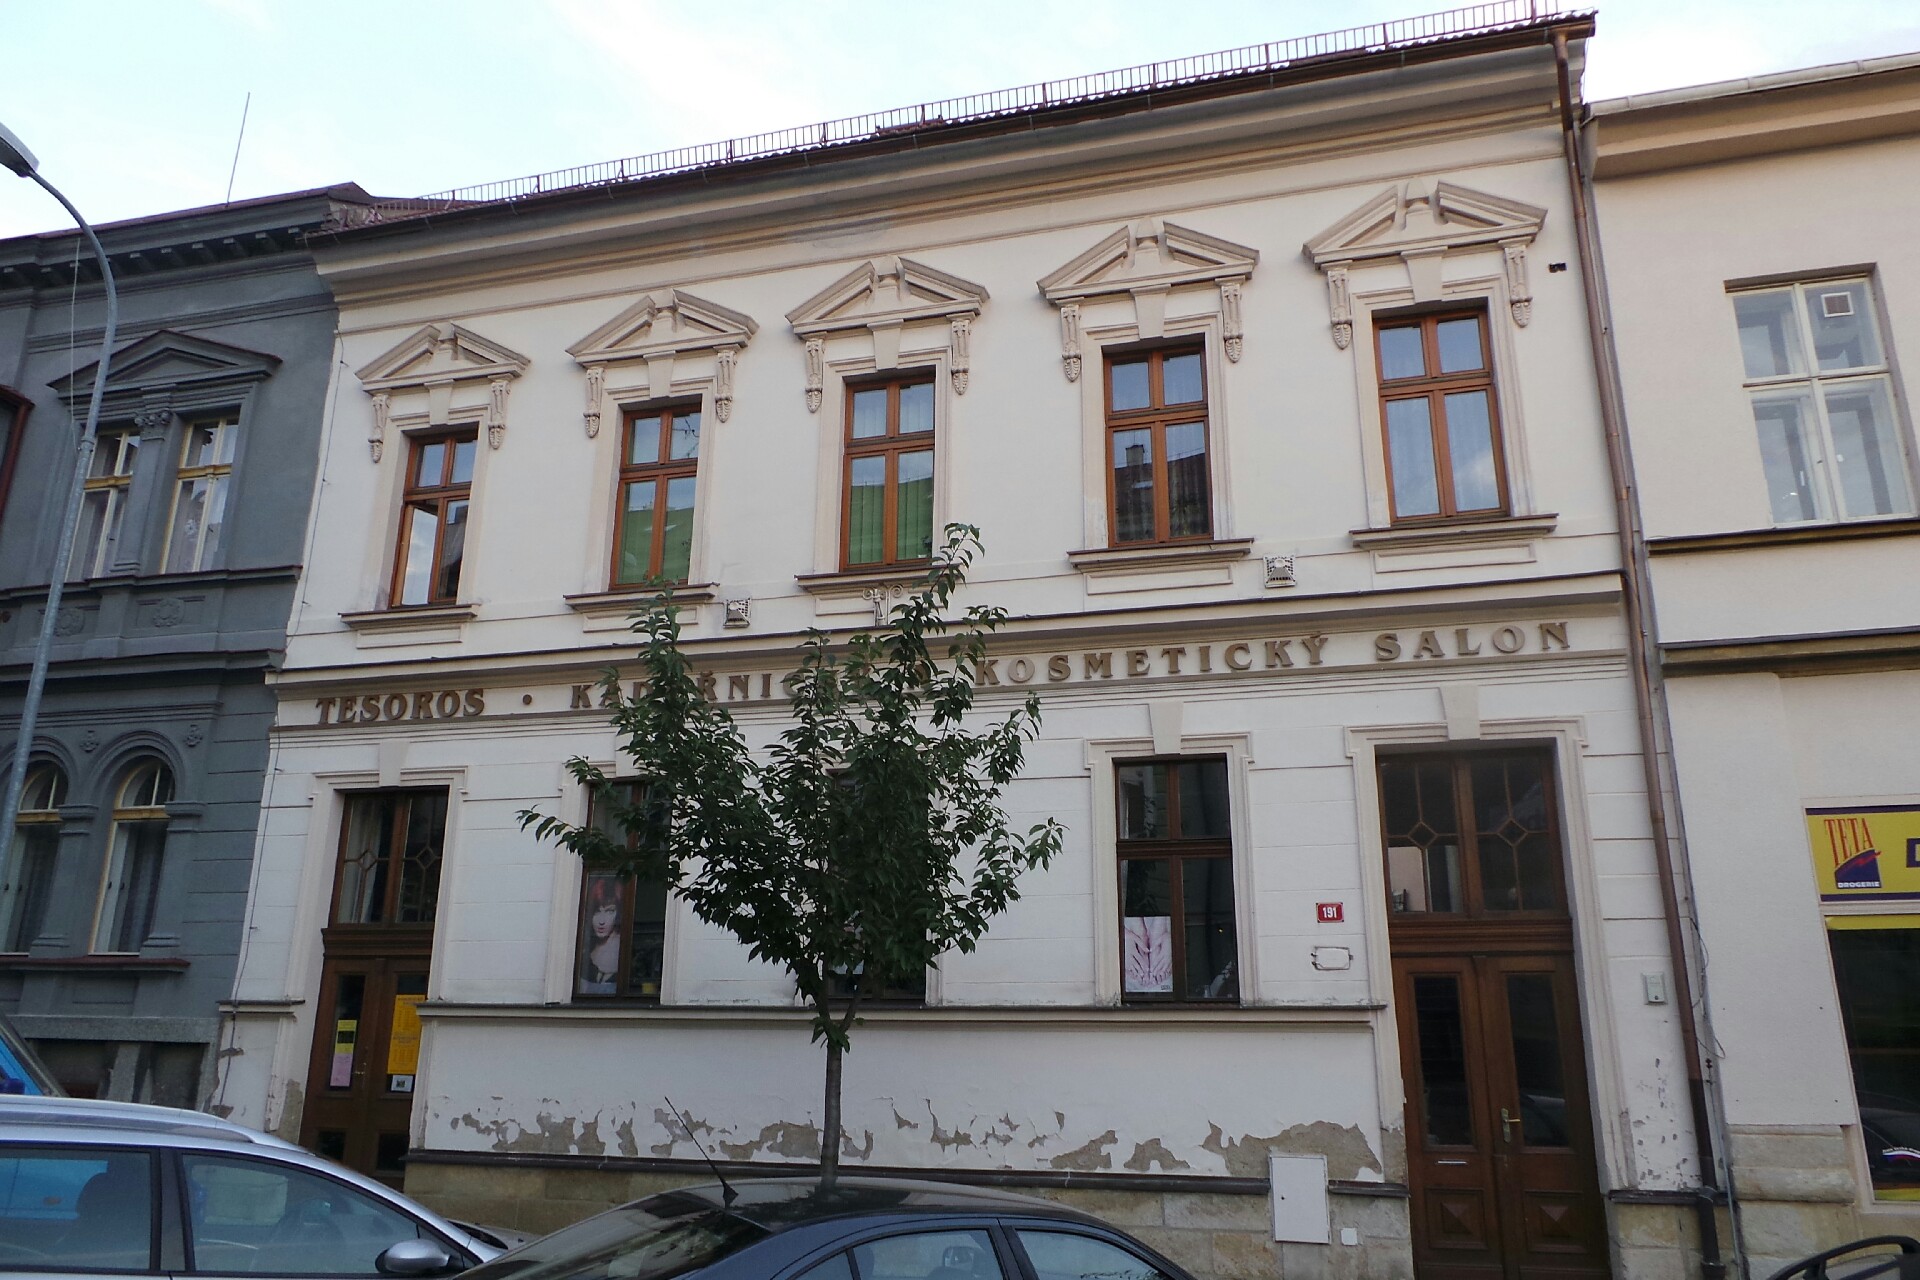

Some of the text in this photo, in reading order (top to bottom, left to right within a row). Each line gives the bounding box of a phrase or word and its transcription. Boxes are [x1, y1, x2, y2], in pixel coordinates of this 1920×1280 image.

[315, 687, 485, 725] TESOROS
[974, 631, 1329, 686] KOSMETICKÝ
[1374, 621, 1571, 661] SALON
[1824, 818, 1874, 868] TETA
[1322, 907, 1337, 918] 191
